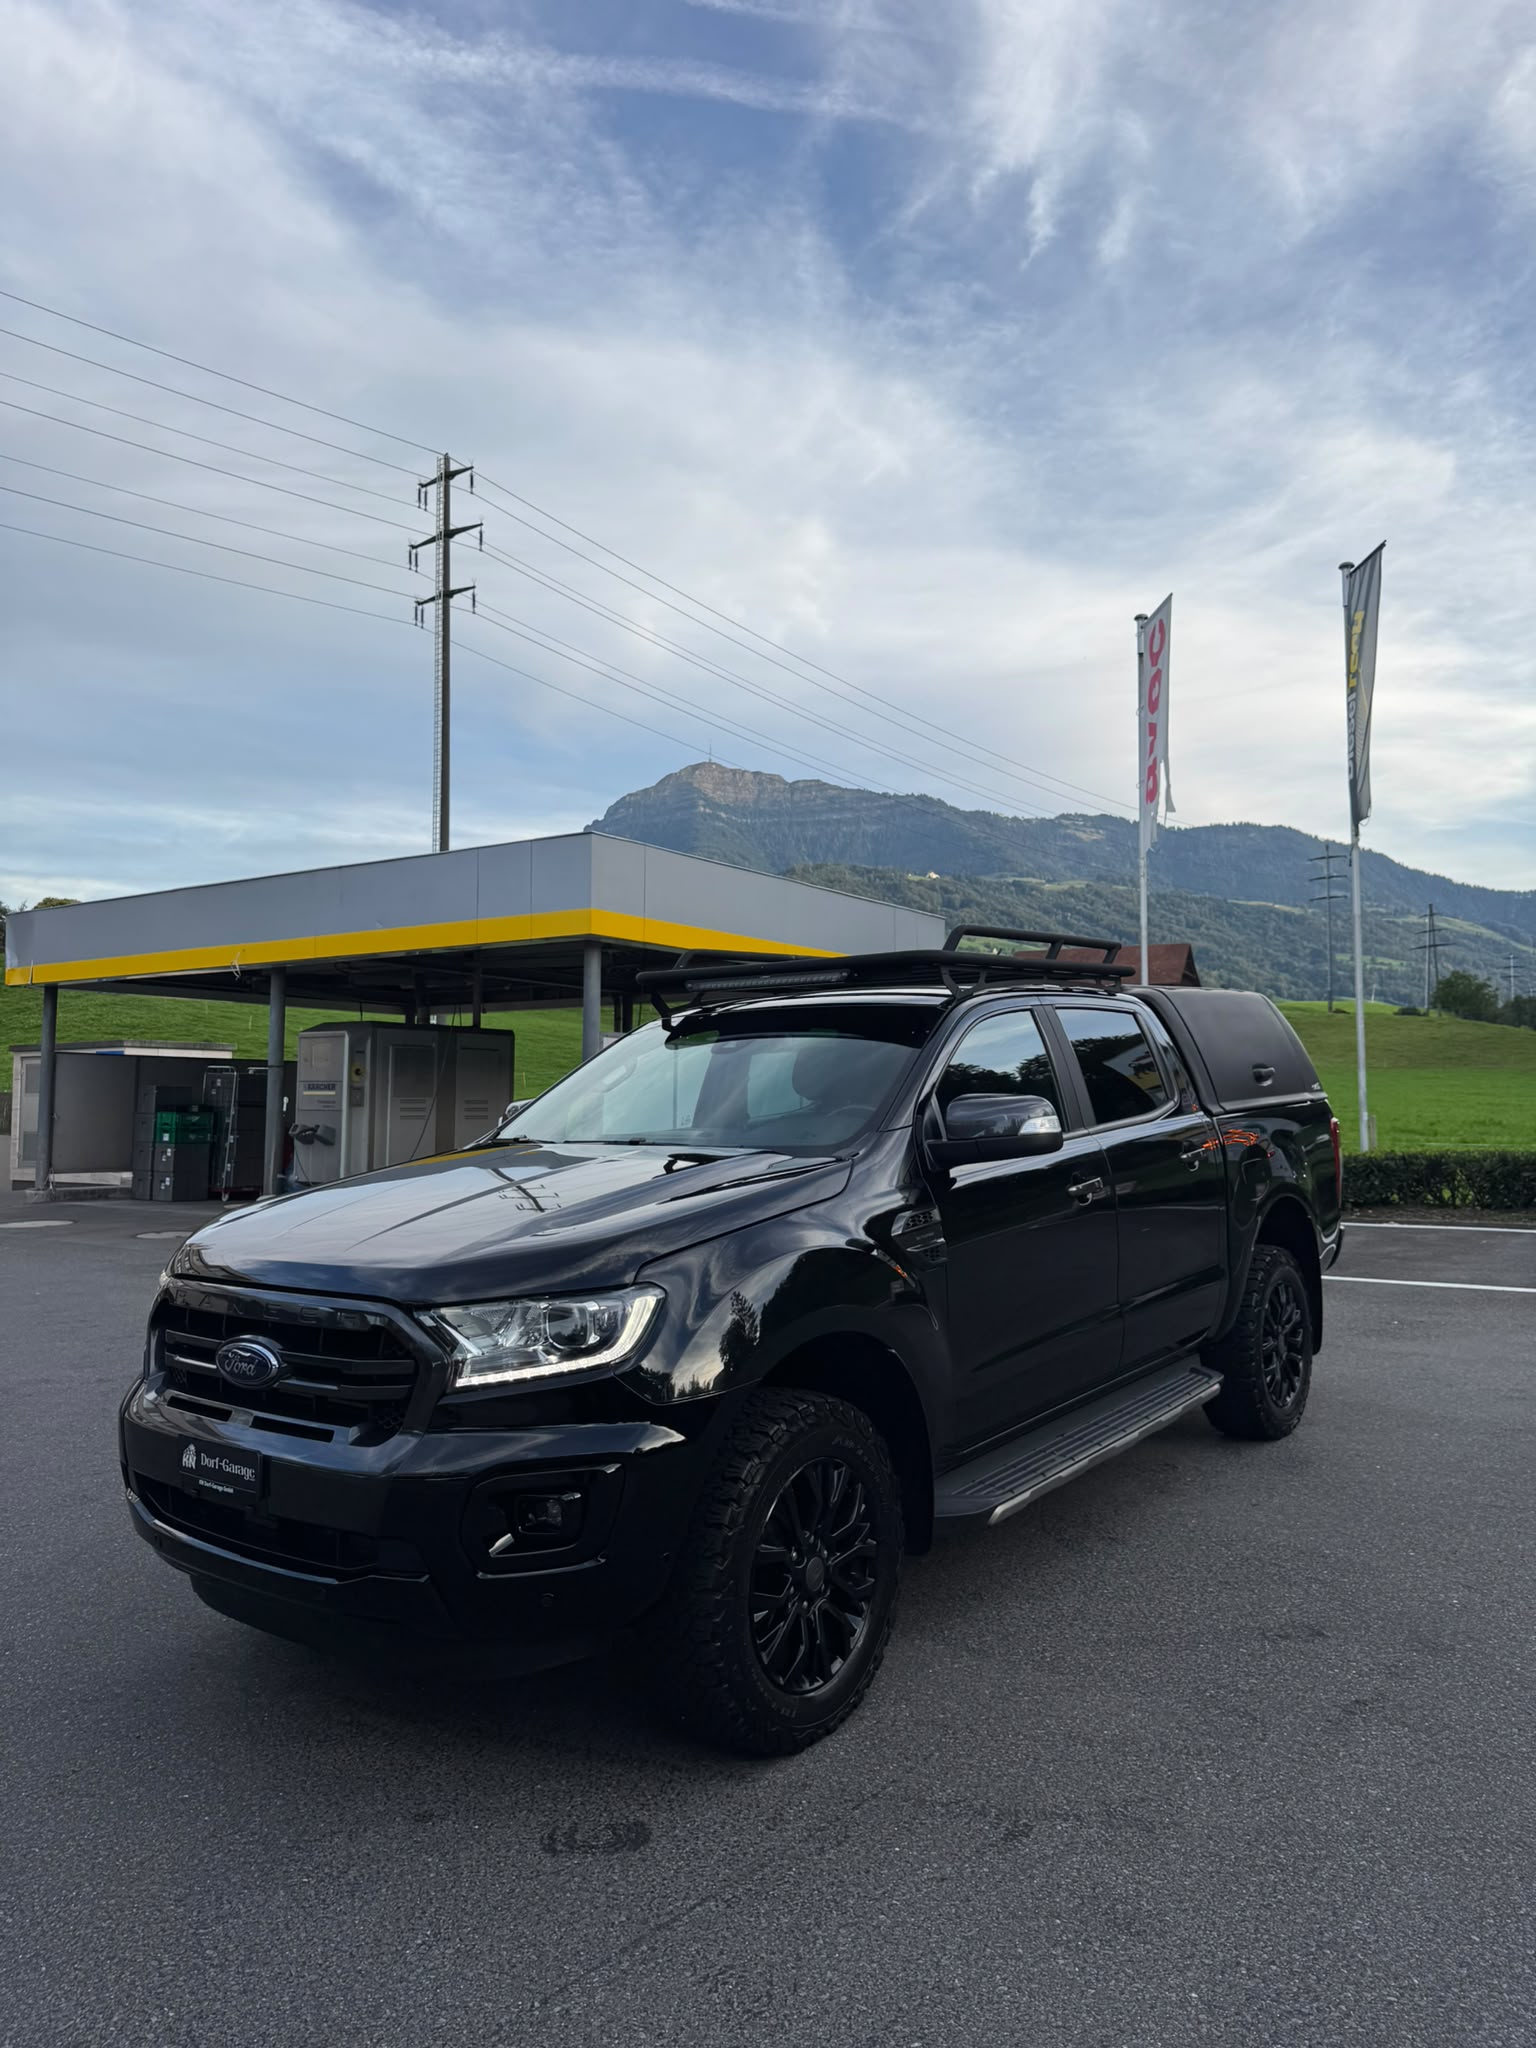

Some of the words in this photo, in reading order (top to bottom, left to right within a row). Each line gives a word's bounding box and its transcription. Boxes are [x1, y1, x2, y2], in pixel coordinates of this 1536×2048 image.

[175, 1289, 363, 1329] RANGER
[224, 1348, 259, 1377] Ford
[200, 1452, 256, 1481] Dorf-Garage
